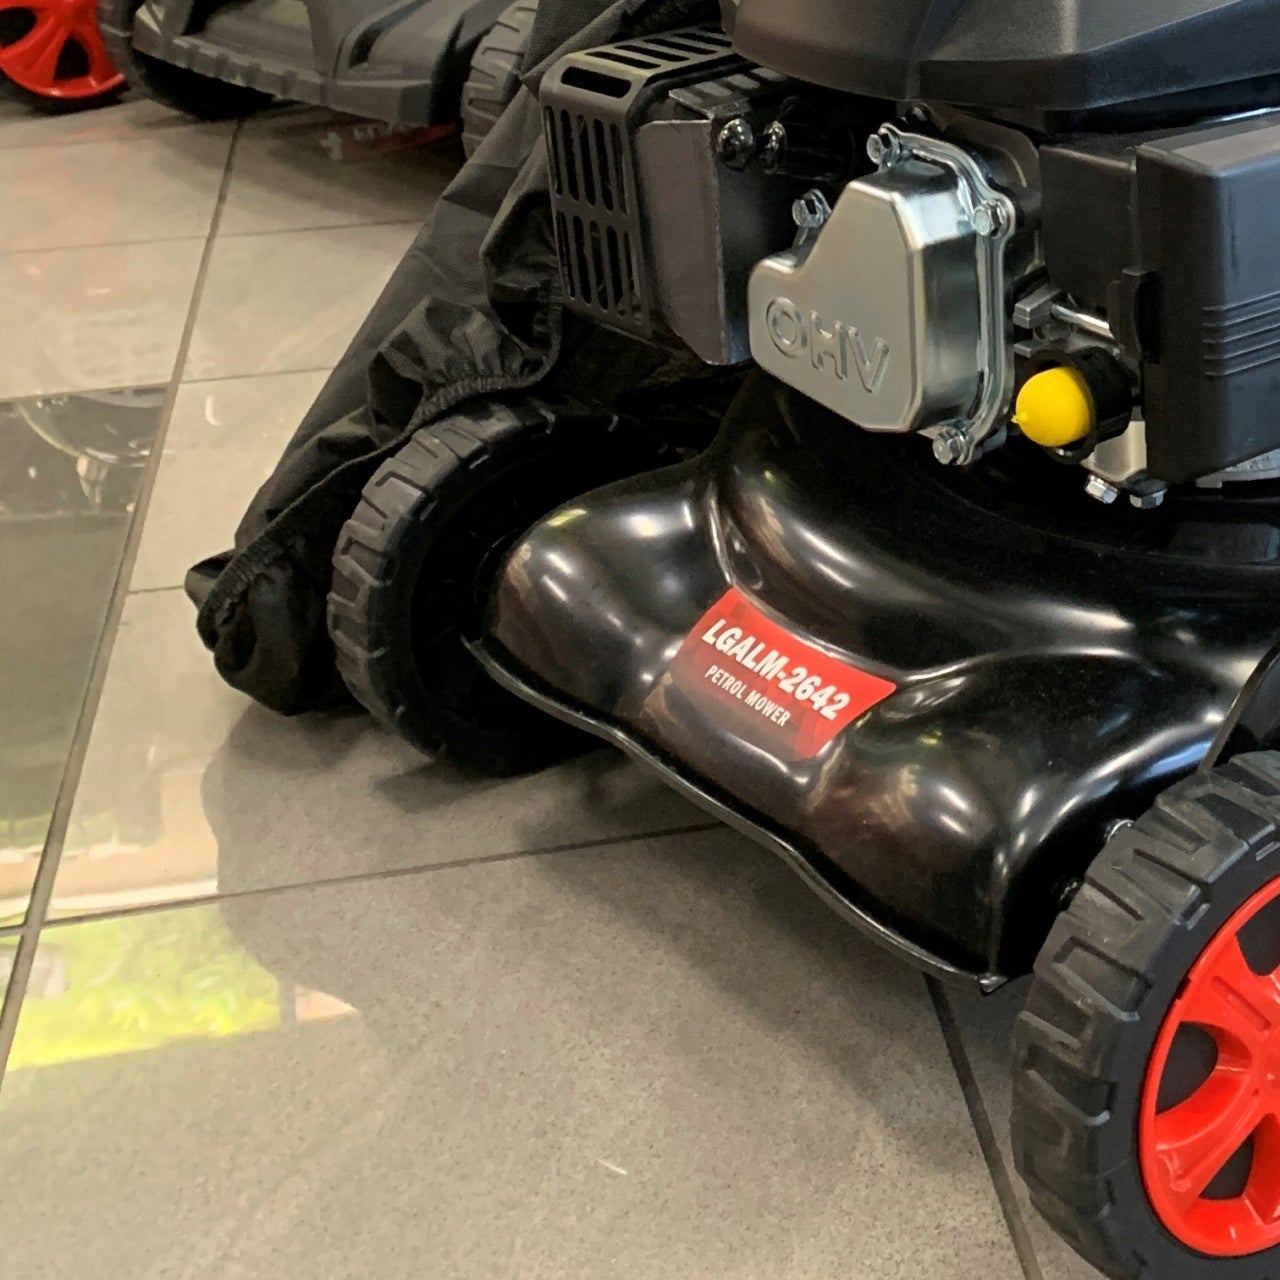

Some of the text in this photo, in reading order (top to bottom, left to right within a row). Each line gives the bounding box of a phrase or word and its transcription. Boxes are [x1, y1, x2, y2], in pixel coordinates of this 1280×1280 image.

[766, 297, 890, 394] OHV
[701, 618, 851, 721] LGALM-2642
[704, 664, 791, 728] PETROL MOWER
